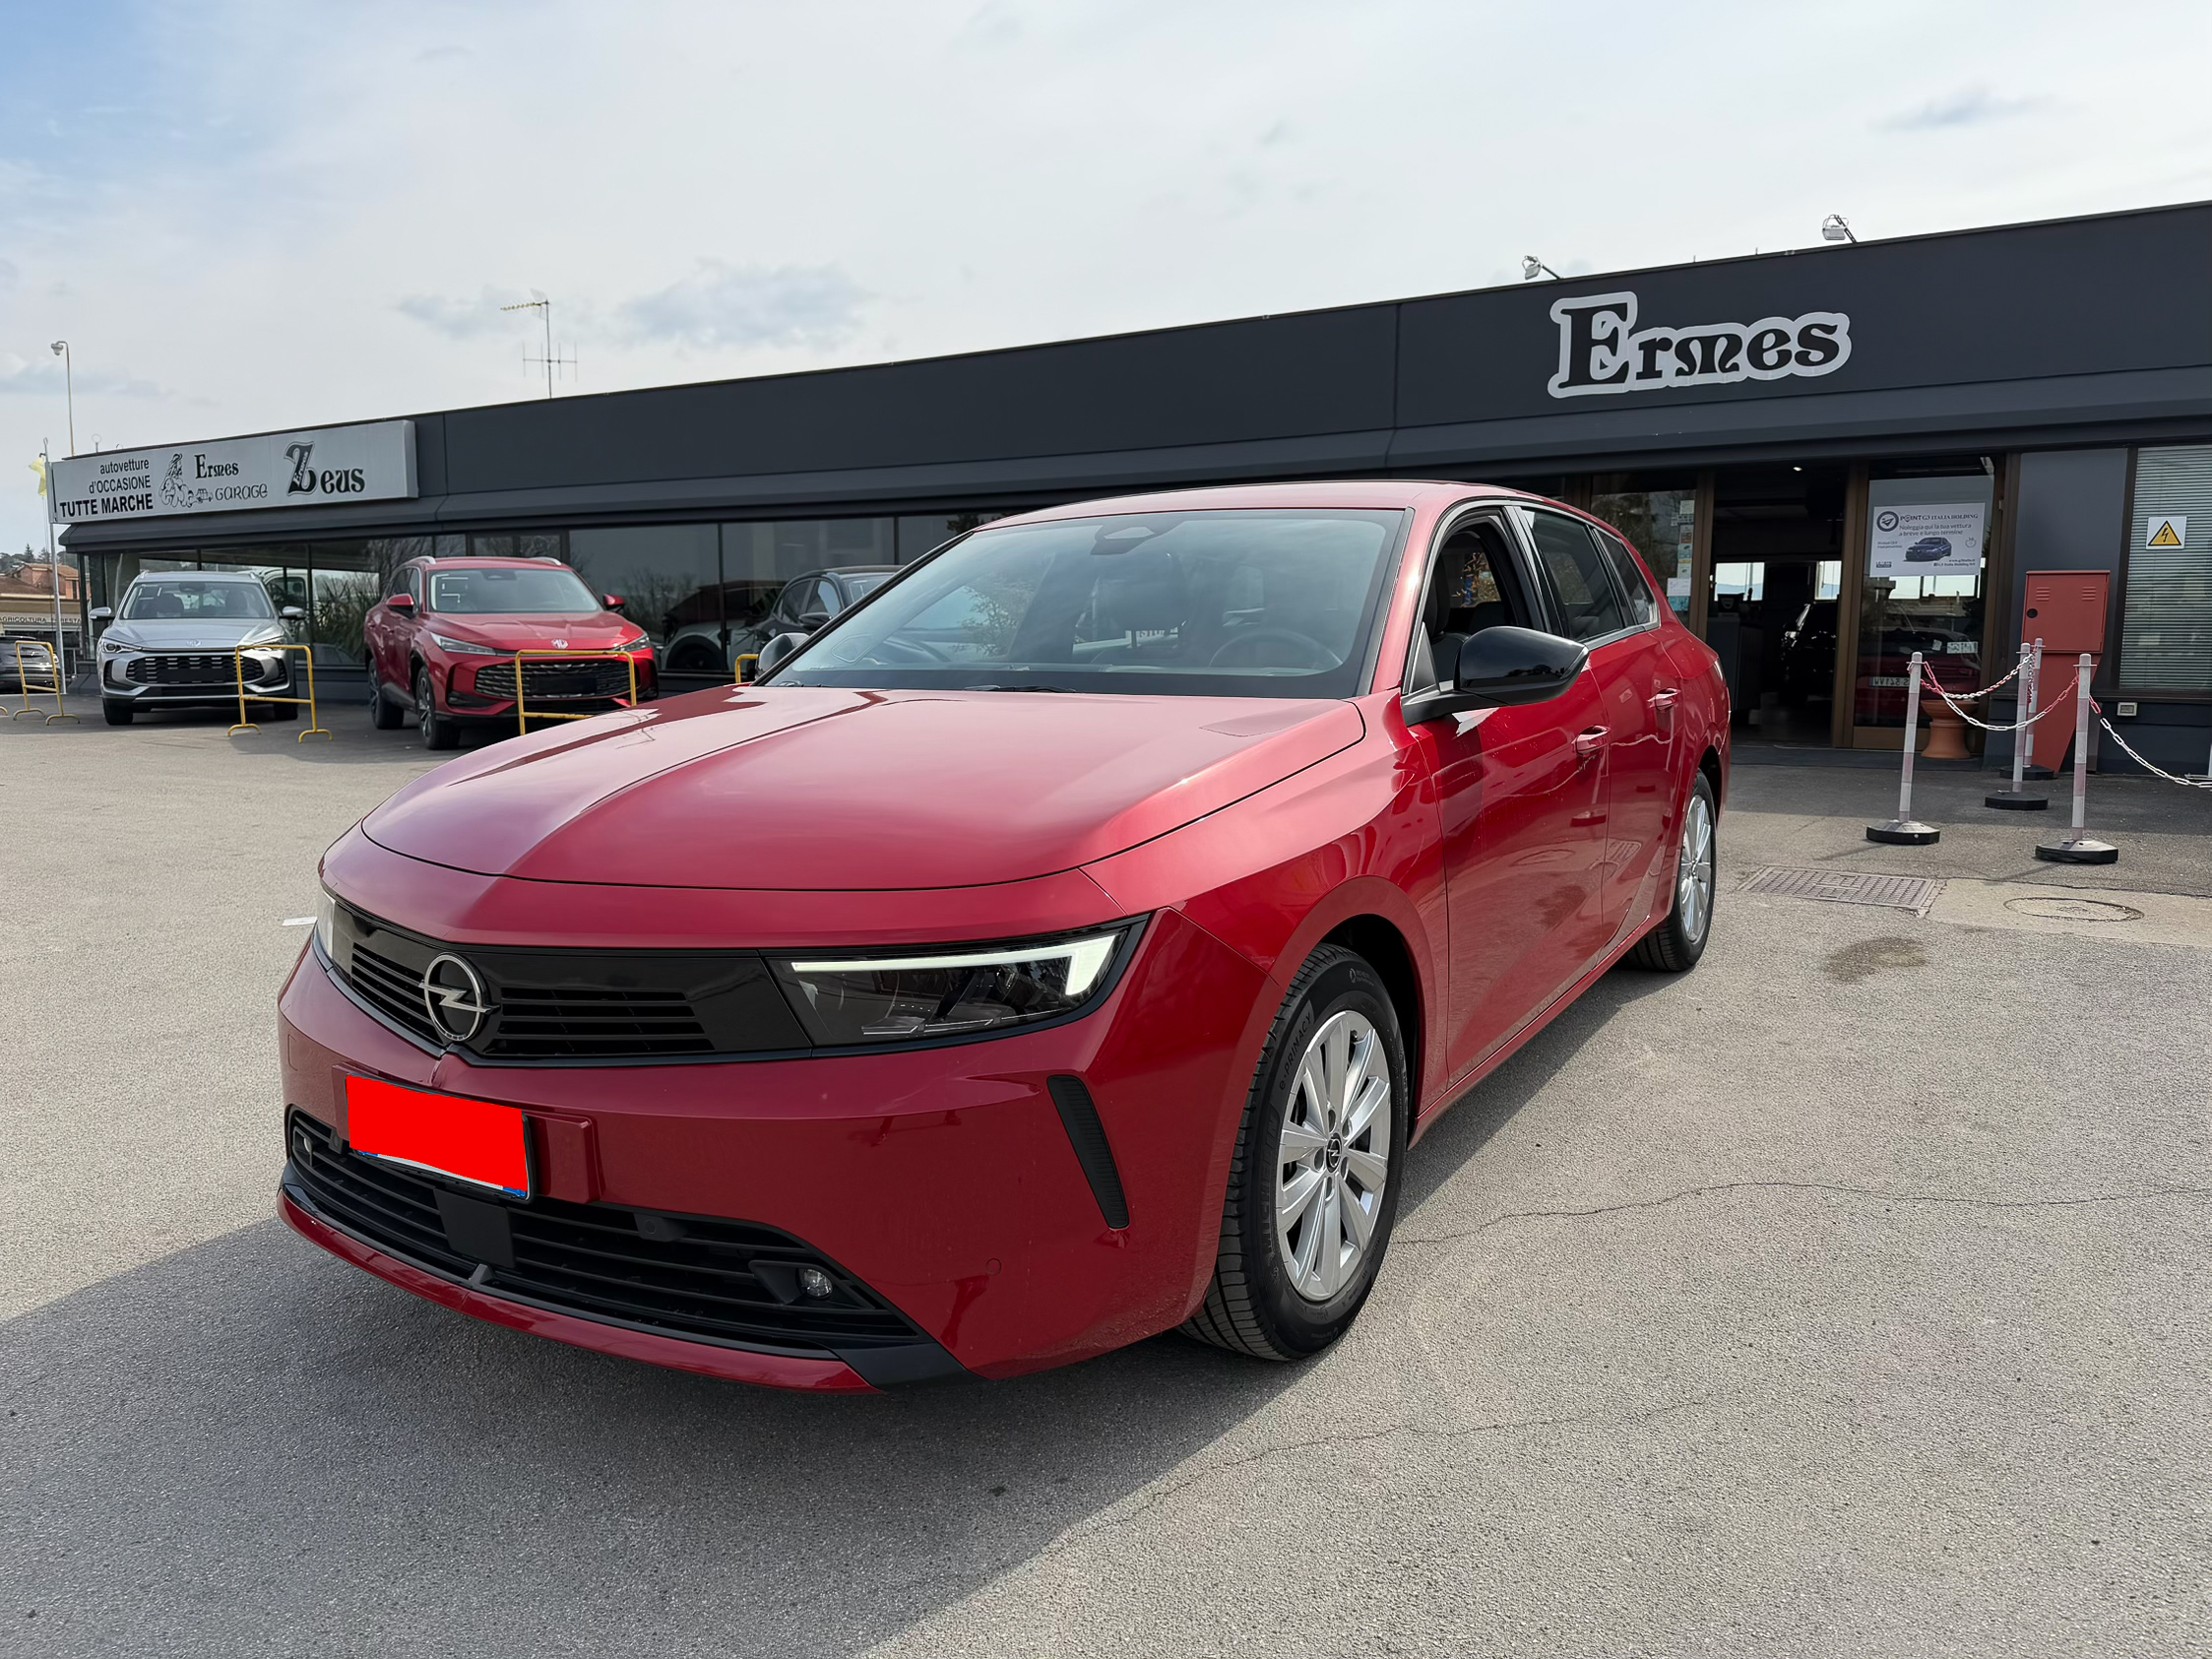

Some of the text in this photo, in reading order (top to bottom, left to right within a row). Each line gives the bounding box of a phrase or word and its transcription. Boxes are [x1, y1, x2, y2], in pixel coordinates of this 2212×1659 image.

[1557, 300, 1841, 390] Ermes
[99, 459, 150, 475] autovetture
[194, 453, 239, 479] Ermes
[284, 441, 365, 495] Zeus
[89, 475, 152, 494] d'OCCASIONE
[59, 492, 154, 518] TUTTE MARCHE
